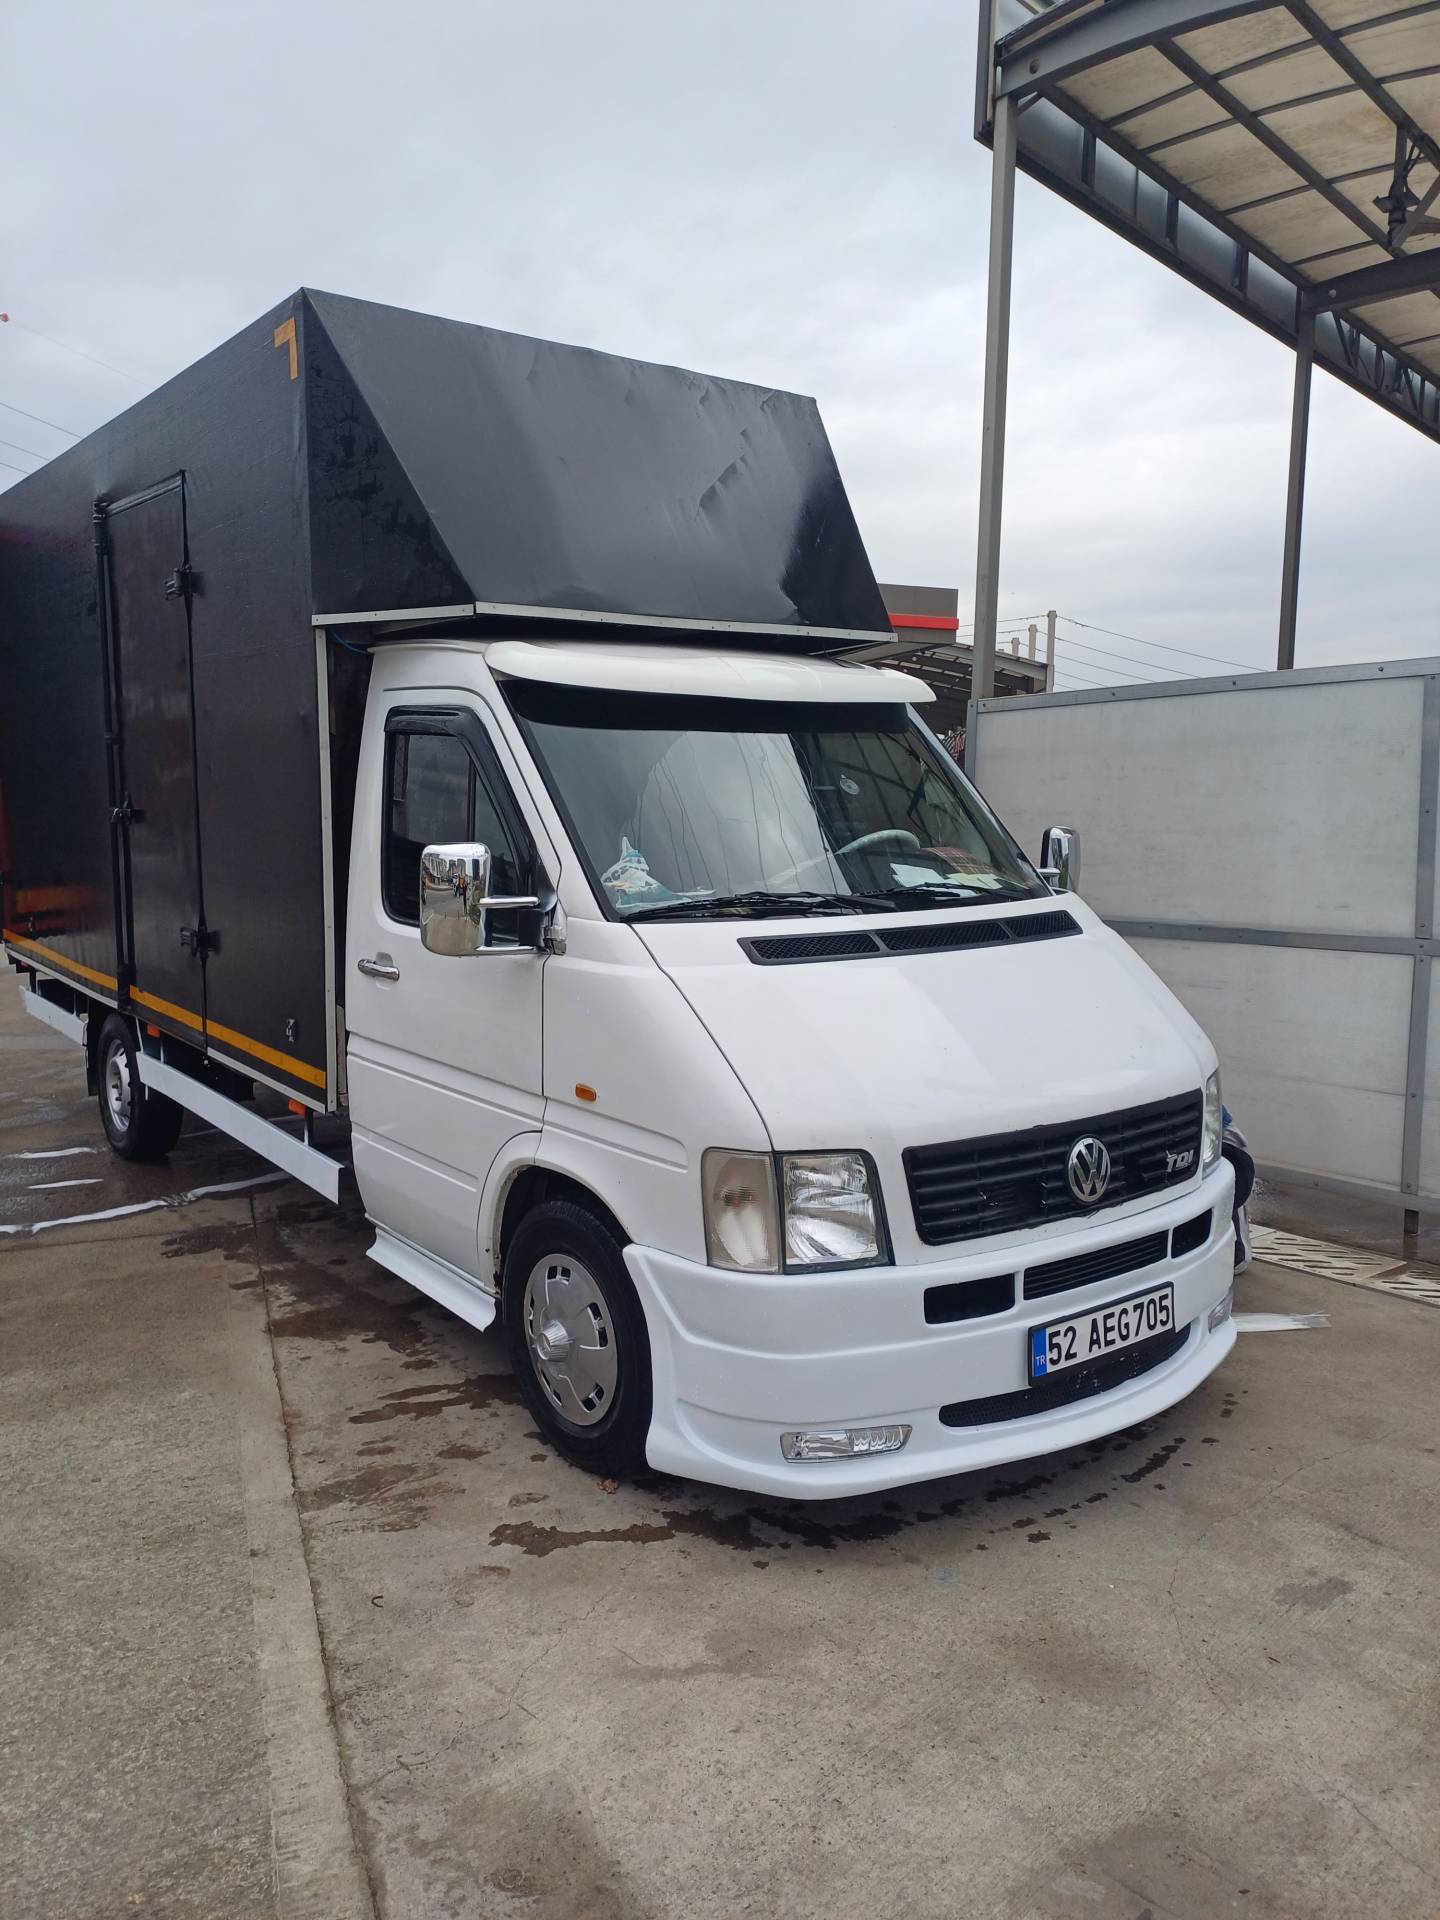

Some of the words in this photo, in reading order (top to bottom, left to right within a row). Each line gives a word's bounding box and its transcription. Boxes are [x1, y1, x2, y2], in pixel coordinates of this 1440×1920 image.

[1166, 1149, 1194, 1173] TDI
[1048, 1325, 1078, 1366] 52
[1035, 1355, 1046, 1367] TR
